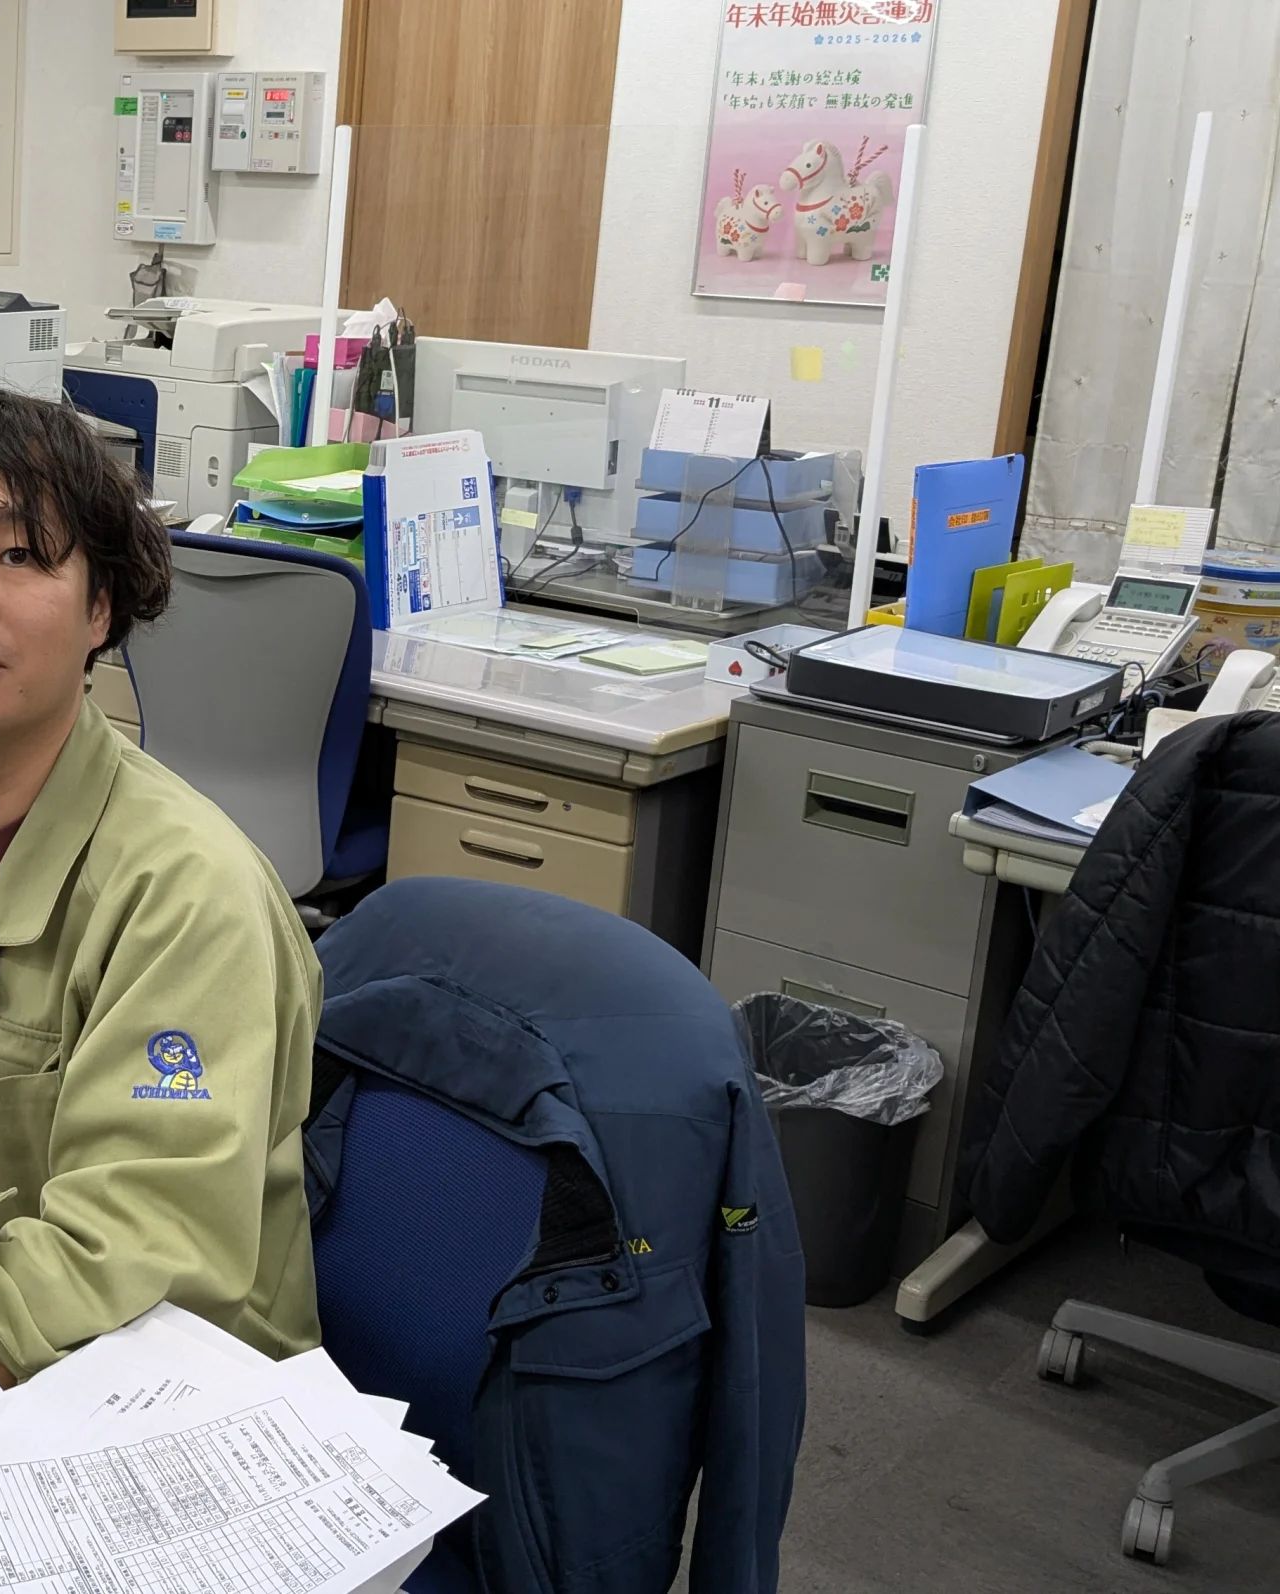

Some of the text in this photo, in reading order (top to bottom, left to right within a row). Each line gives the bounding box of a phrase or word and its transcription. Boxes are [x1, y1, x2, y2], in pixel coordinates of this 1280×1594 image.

[827, 34, 907, 45] 2025-2026
[725, 69, 862, 87] 「年末」感謝の総点検
[723, 93, 913, 110] 「年始」も笑顔で 無事故の発進
[533, 358, 571, 369] DATA
[708, 397, 720, 408] 11
[160, 1447, 169, 1455] 10
[169, 1444, 178, 1452] 20
[141, 1452, 150, 1460] 10
[210, 1473, 221, 1483] 200
[182, 1482, 193, 1492] 200
[191, 1479, 202, 1489] 200
[163, 1488, 174, 1498] 200
[173, 1485, 183, 1495] 200
[115, 1501, 127, 1512] 200
[134, 1496, 146, 1507] 200
[106, 1503, 117, 1515] 200
[266, 1519, 276, 1527] 10
[247, 1526, 257, 1535] 10
[179, 1549, 189, 1560] 20
[291, 1550, 302, 1560] 200
[150, 1558, 160, 1569] 10
[159, 1556, 169, 1566] 10
[272, 1559, 284, 1570] 200
[199, 1543, 235, 1594] 200 10
